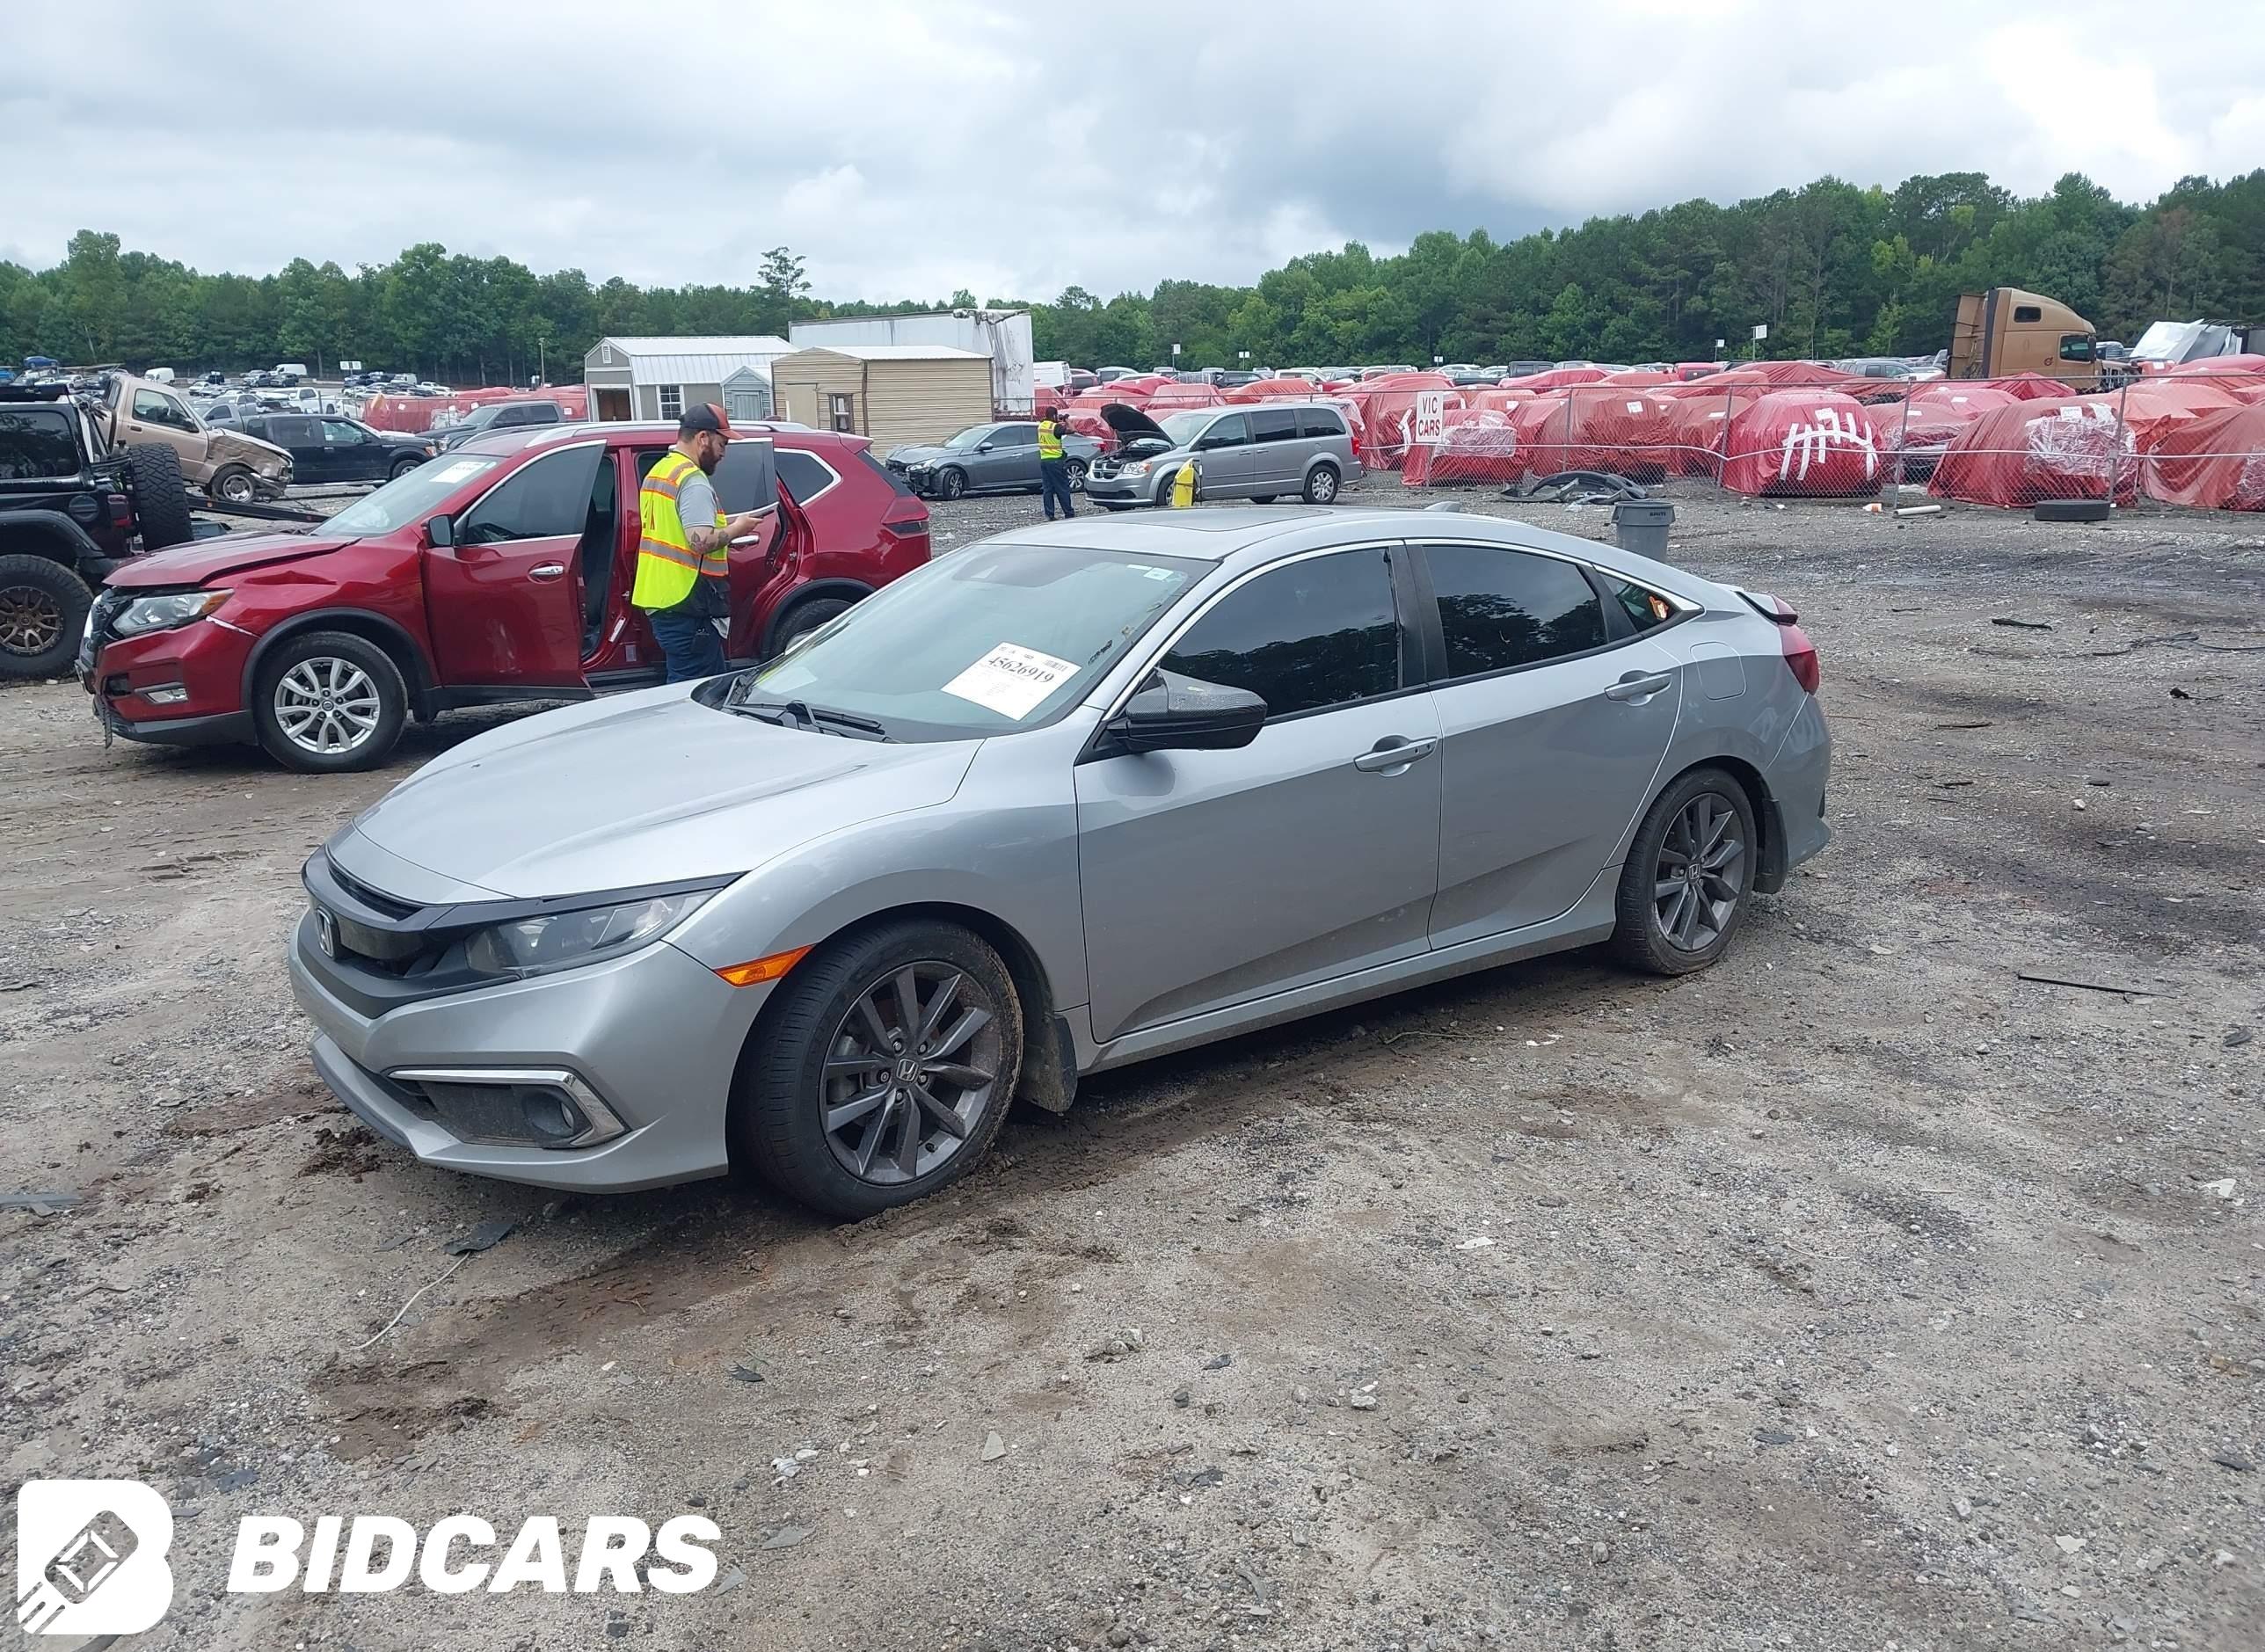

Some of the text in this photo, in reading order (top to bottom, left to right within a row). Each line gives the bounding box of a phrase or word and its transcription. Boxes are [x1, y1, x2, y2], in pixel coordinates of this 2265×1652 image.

[1422, 397, 1438, 414] VIC
[1418, 418, 1440, 436] CARS
[988, 656, 1054, 683] 45626919
